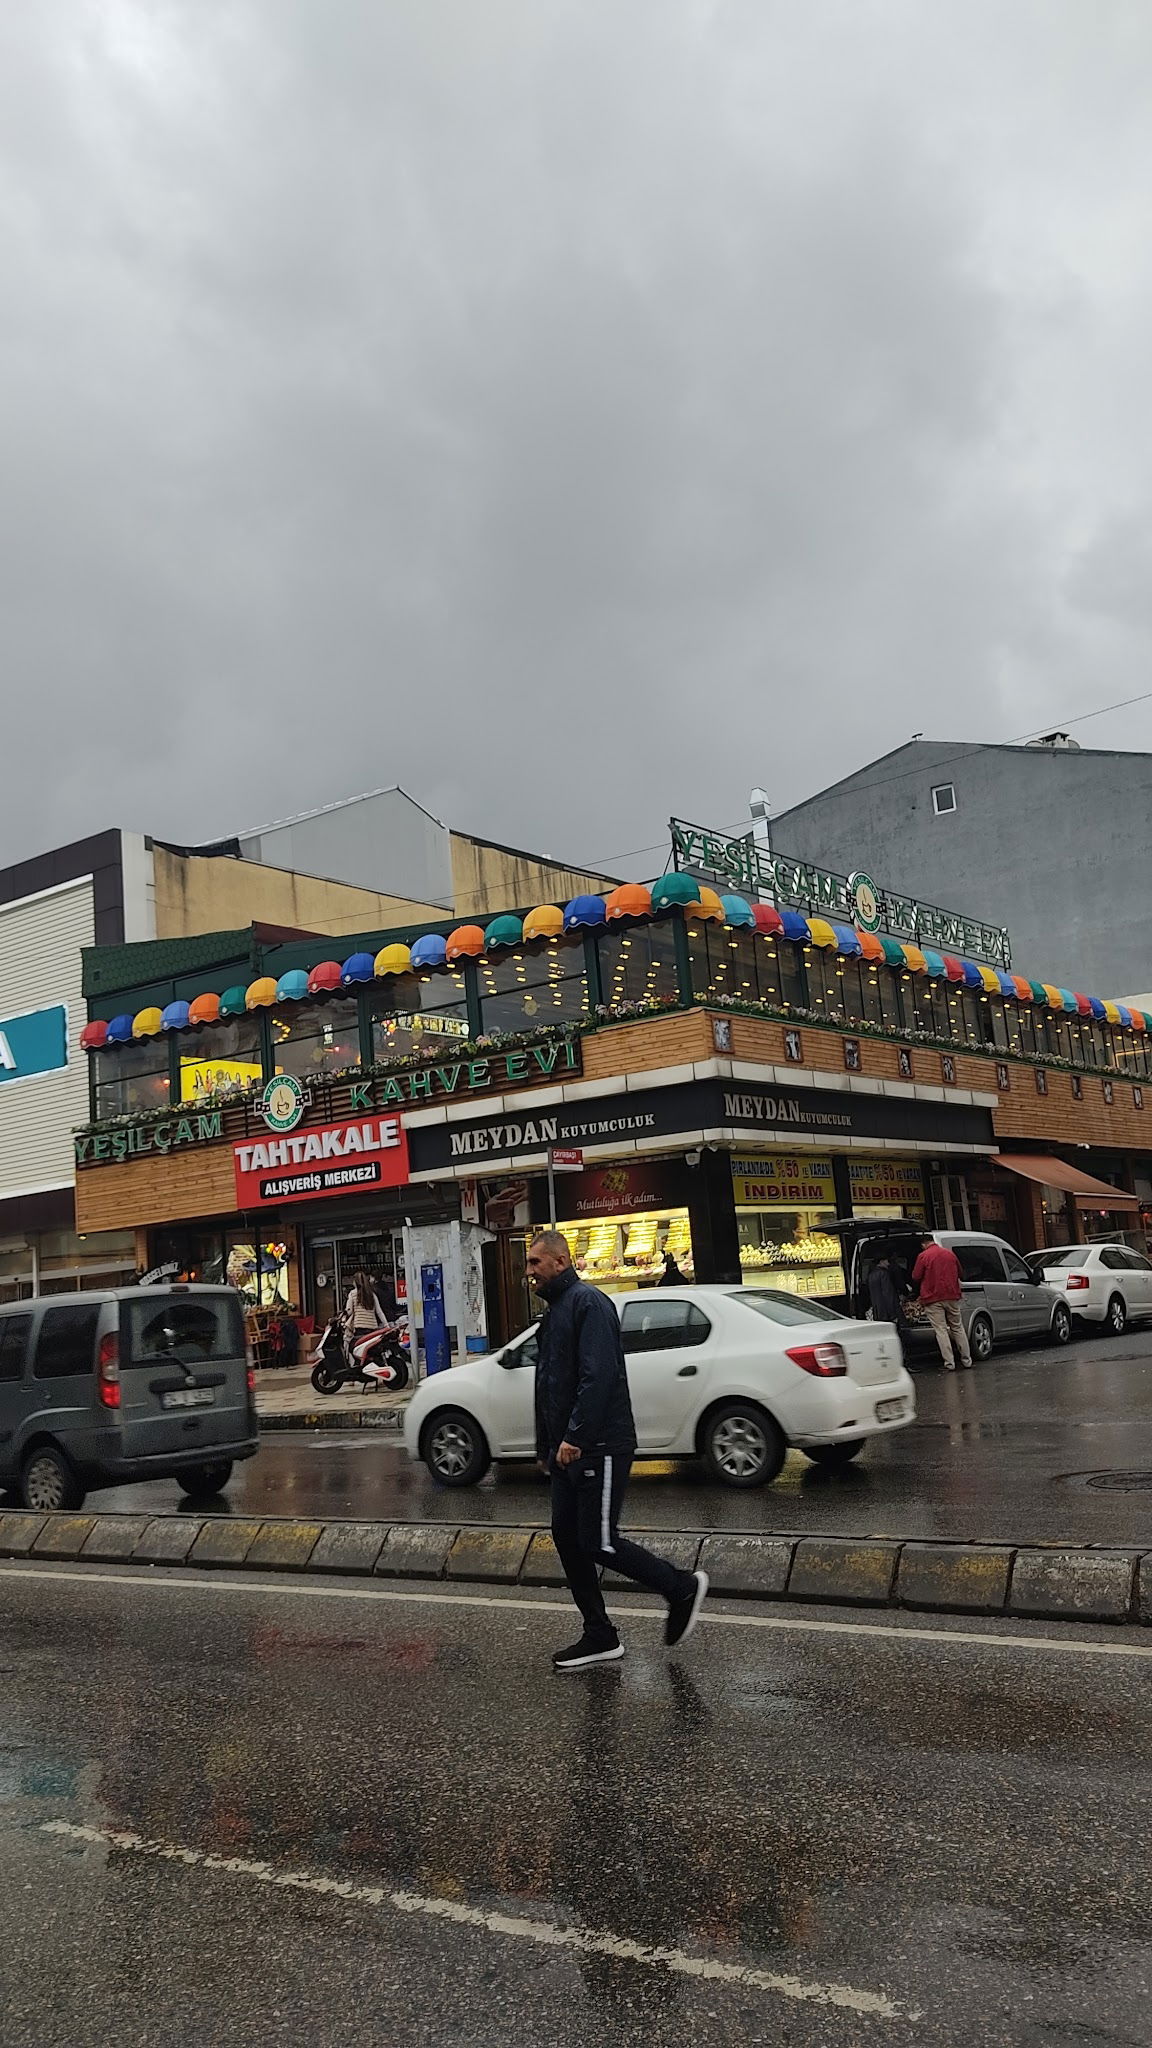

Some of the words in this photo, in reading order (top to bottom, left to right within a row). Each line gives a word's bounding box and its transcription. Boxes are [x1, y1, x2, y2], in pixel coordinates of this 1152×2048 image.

[350, 1058, 491, 1110] KAHVE
[723, 1093, 800, 1122] MEYDAN
[800, 1112, 852, 1126] KUYUMCULUK
[235, 1118, 400, 1172] TAHTAKALE
[450, 1117, 558, 1156] MEYDAN
[560, 1113, 655, 1139] KUYUMCULUK
[264, 1174, 322, 1196] ALIŞVERİŞ
[324, 1163, 377, 1187] MERKEZİ
[775, 1158, 799, 1178] %50
[576, 1196, 620, 1211] Mutluluğa
[621, 1193, 636, 1207] ilk
[744, 1181, 825, 1199] İNDİRİM
[851, 1183, 921, 1200] İNDİRİM
